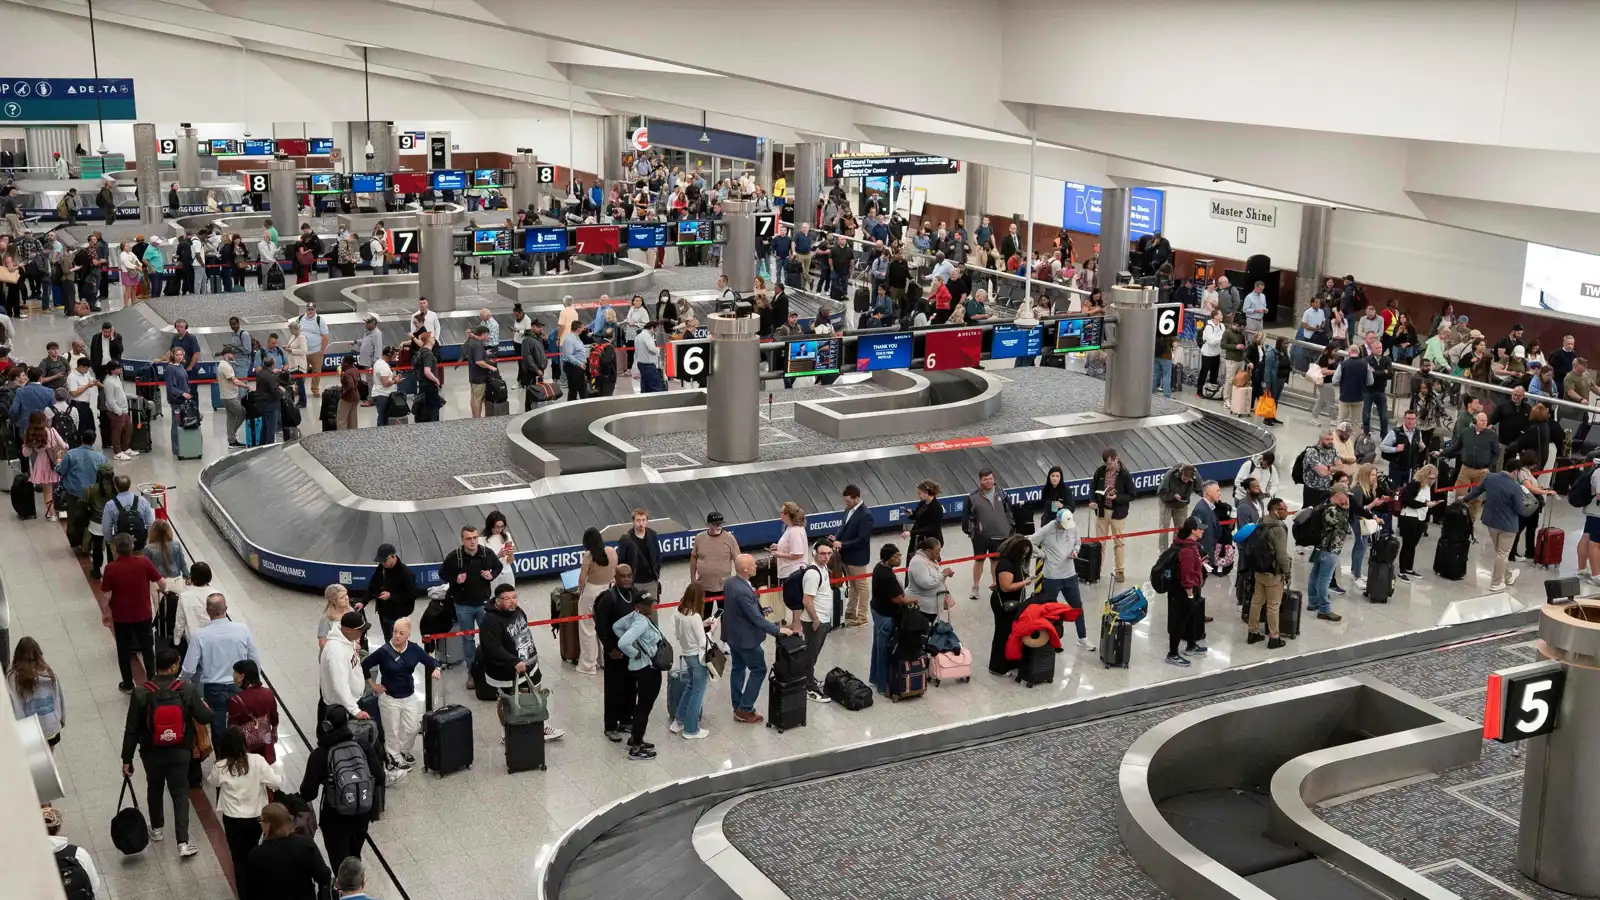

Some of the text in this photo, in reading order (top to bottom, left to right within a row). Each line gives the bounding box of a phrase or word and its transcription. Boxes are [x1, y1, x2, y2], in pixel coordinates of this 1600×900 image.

[162, 140, 174, 153] 9
[402, 136, 411, 148] 9
[253, 176, 266, 191] 8
[541, 168, 551, 182] 8
[393, 184, 400, 193] 8
[1211, 202, 1273, 222] Master Shine
[760, 217, 772, 235] 7
[399, 232, 413, 252] 7
[577, 241, 585, 253] 7
[1158, 309, 1175, 335] 6
[683, 346, 704, 375] 6
[926, 353, 936, 369] 6
[514, 554, 549, 573] YOUR
[551, 550, 584, 568] FIRST
[673, 535, 696, 551] FLIE
[262, 559, 307, 578] DELTA.COM/AMEX
[1515, 680, 1552, 733] 5
